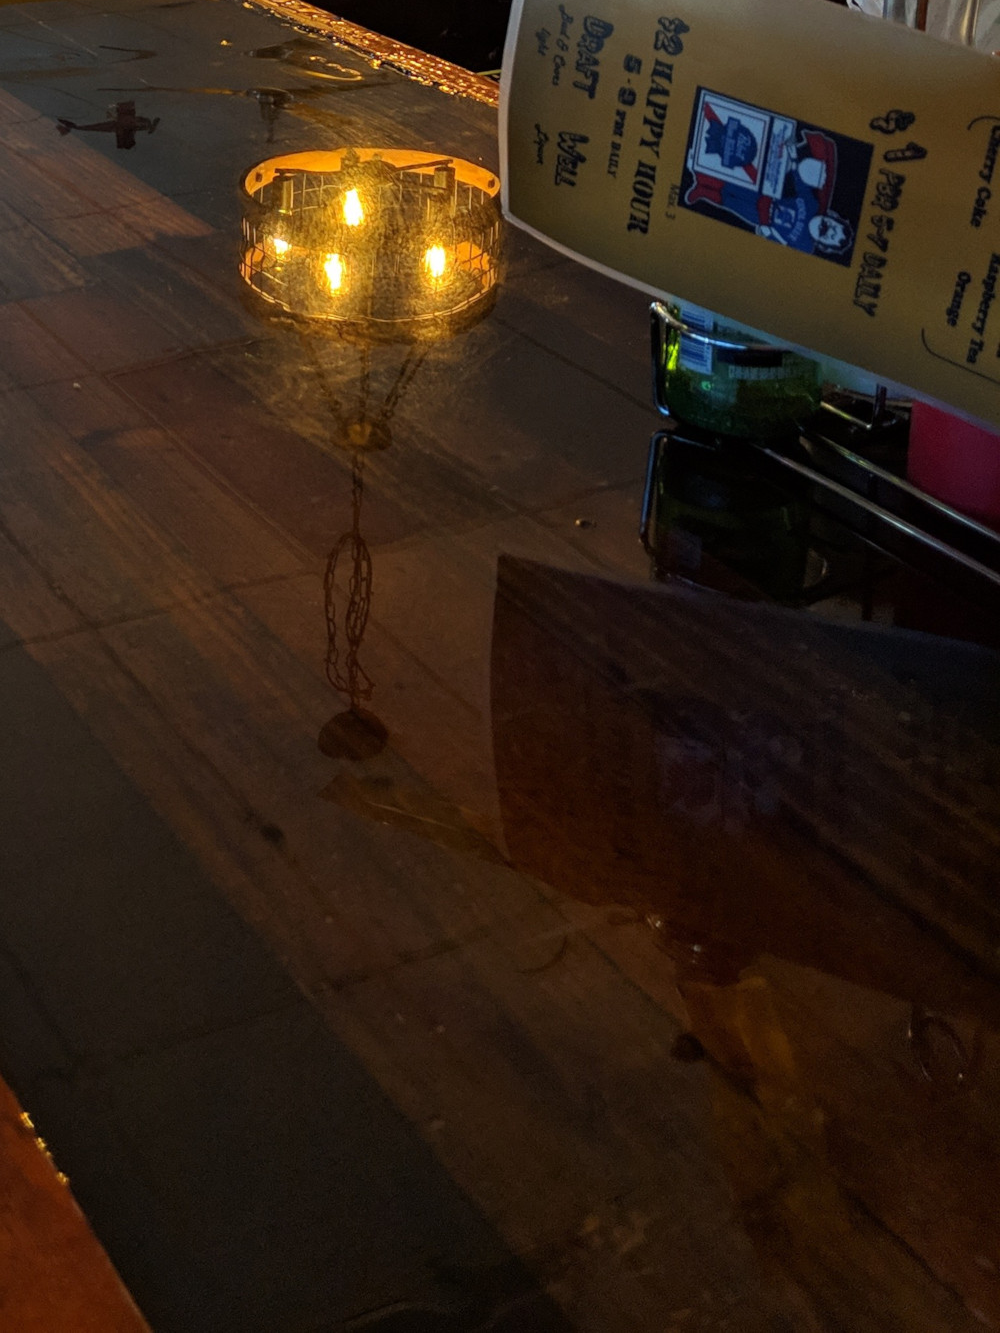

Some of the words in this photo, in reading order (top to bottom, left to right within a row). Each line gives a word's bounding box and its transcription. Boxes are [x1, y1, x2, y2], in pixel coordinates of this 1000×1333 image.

[558, 4, 574, 39] Bud
[653, 16, 690, 56] $2
[572, 15, 614, 100] DRAFT
[639, 58, 674, 160] HAPPY
[533, 123, 550, 165] Liquor
[607, 140, 622, 179] DAILY
[627, 159, 657, 236] HOUR
[970, 186, 992, 230] Cake
[853, 250, 889, 317] DAILY
[946, 271, 972, 328] Orange
[971, 253, 1000, 336] Raspberry
[966, 337, 985, 364] Tea
